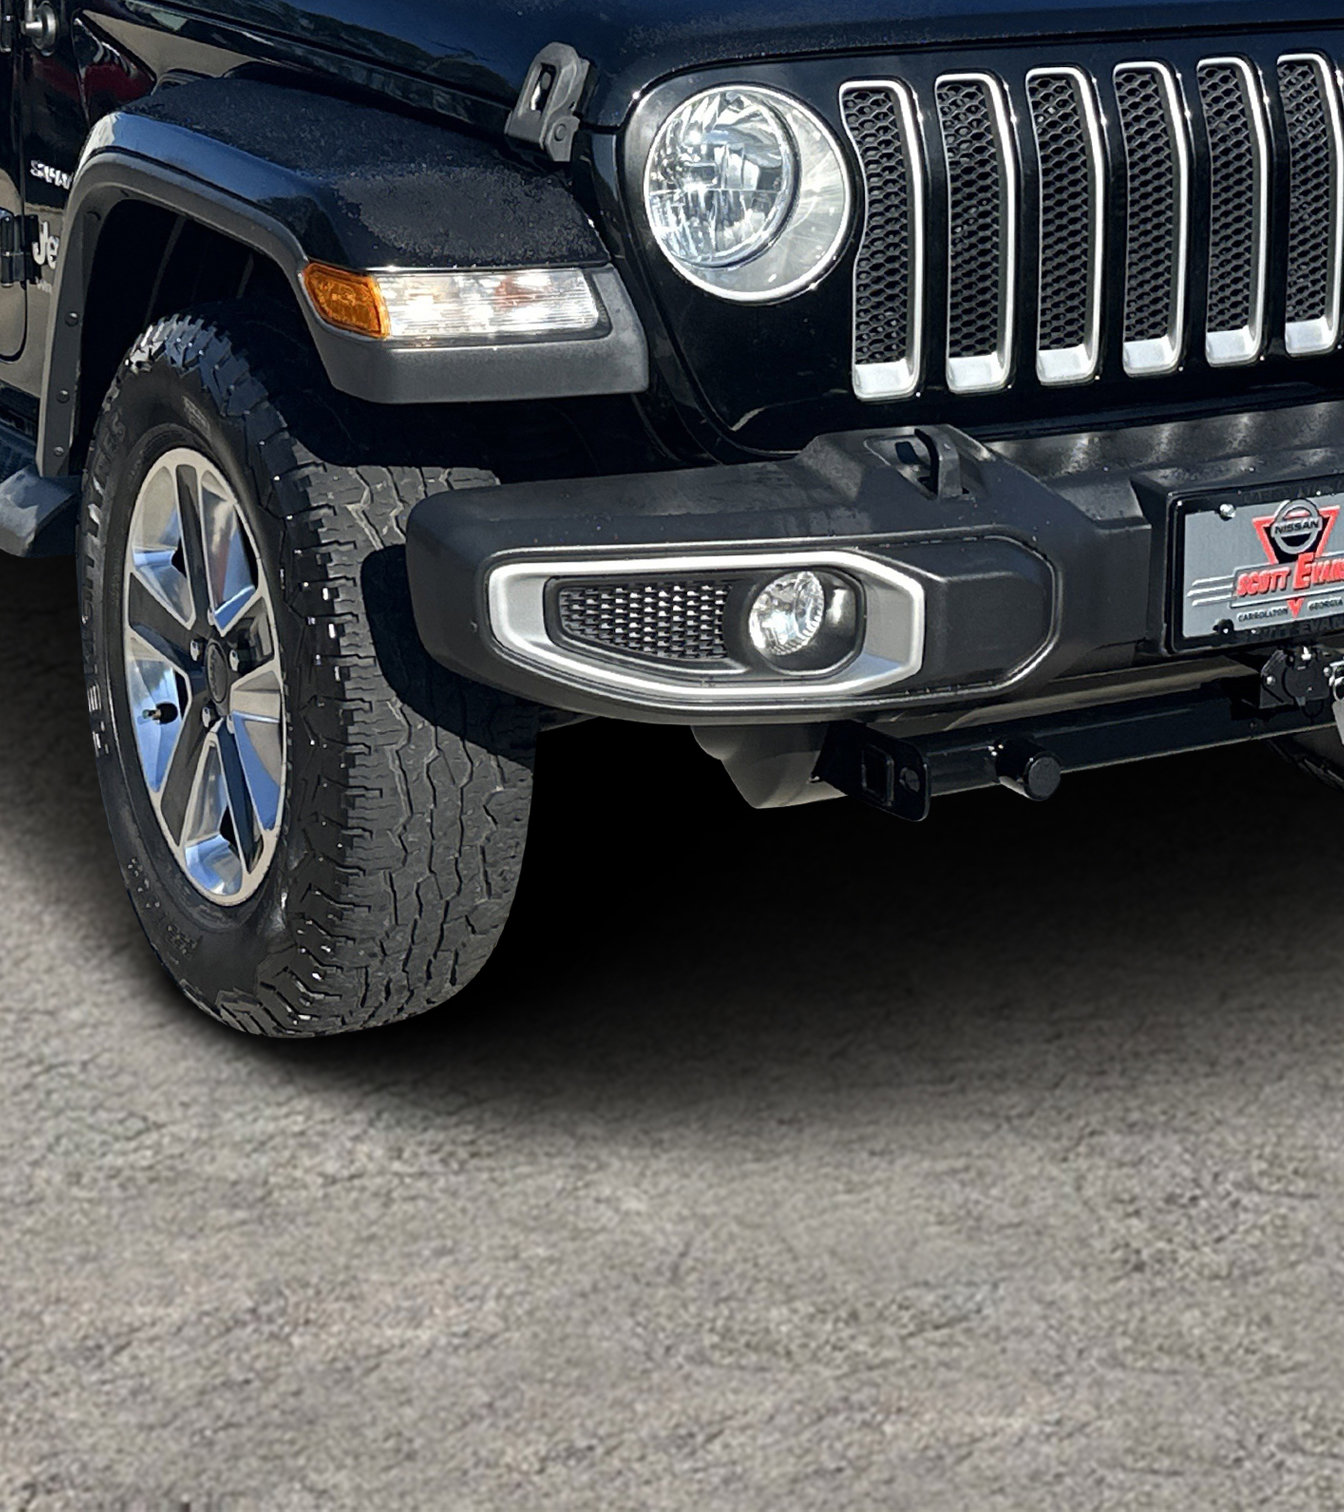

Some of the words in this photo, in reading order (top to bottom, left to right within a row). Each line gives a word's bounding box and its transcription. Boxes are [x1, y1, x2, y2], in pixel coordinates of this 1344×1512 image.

[32, 221, 60, 269] Je
[1275, 519, 1319, 534] NISSAN
[1237, 567, 1290, 596] SCOTT
[1239, 609, 1288, 621] CARROLLTON
[1309, 600, 1344, 611] GEORGIA
